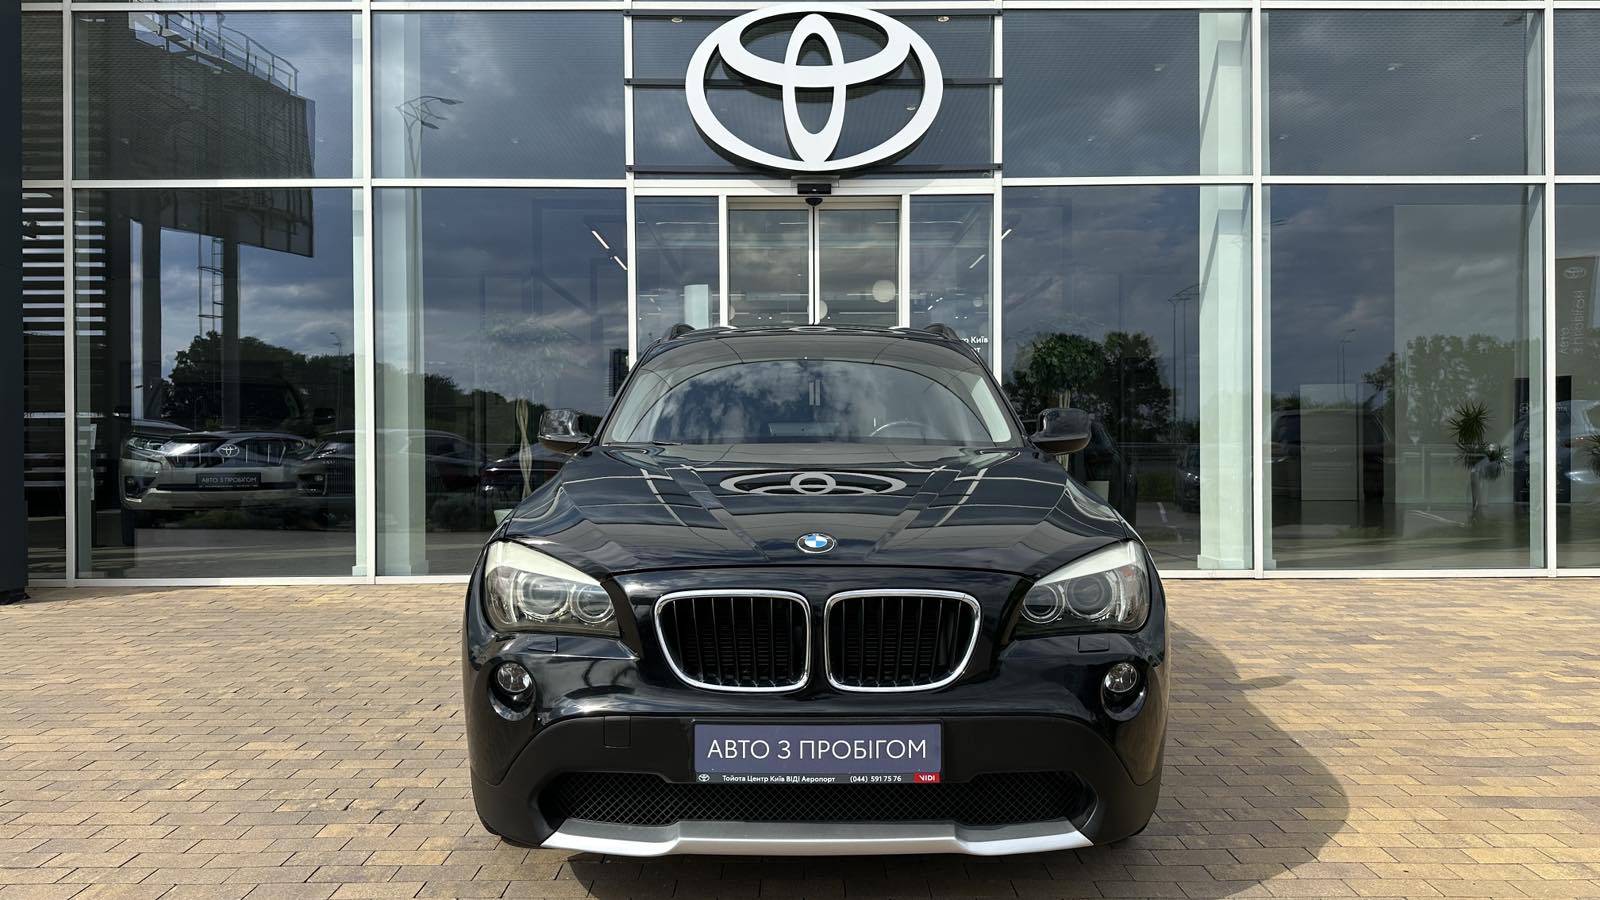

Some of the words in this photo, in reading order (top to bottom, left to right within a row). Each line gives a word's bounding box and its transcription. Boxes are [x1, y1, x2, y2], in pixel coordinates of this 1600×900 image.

[707, 739, 770, 759] АВТО
[777, 739, 791, 759] З
[799, 739, 926, 759] ПРОБІГОМ
[747, 775, 769, 783] Центр
[786, 775, 801, 783] ВІДІ
[801, 775, 836, 783] Аеропорт
[849, 775, 869, 783] (044)
